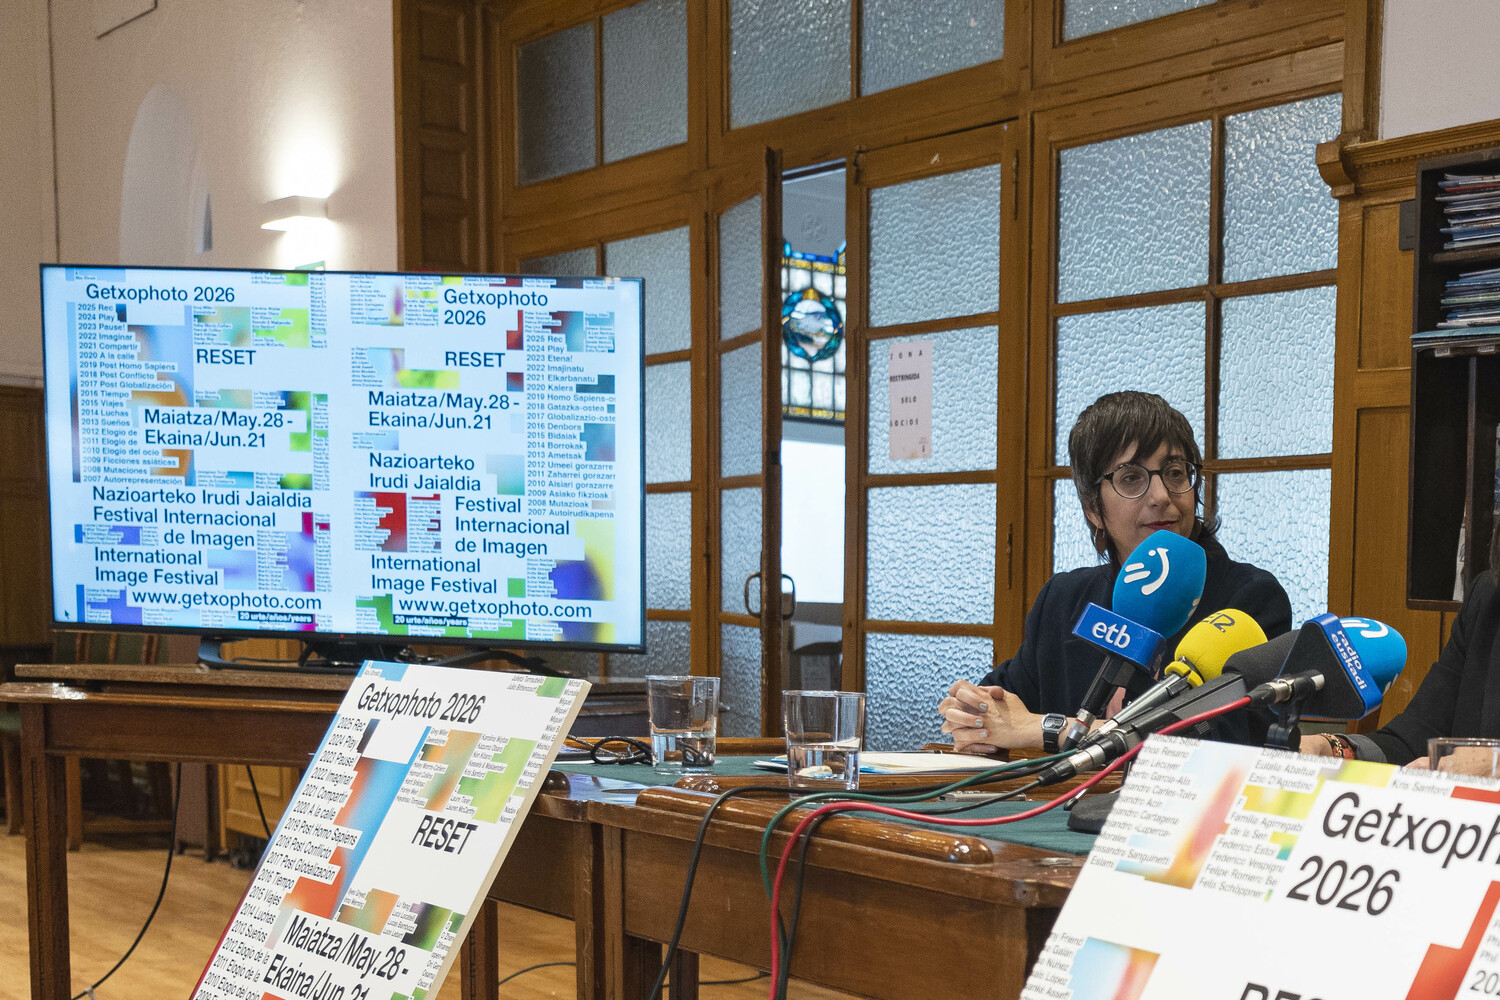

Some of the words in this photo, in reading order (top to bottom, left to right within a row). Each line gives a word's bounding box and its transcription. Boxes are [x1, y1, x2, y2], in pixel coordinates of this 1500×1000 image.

[85, 283, 188, 304] Getxophoto
[193, 286, 235, 303] 2026
[443, 288, 548, 310] Getxophoto
[78, 322, 97, 331] 2023
[98, 322, 125, 331] Pause!
[444, 309, 486, 326] 2026
[196, 348, 257, 365] RESET
[445, 351, 506, 368] RESET
[526, 383, 546, 392] 2020
[547, 384, 574, 392] Kalera
[368, 390, 510, 415] Maiatza/May.28
[144, 408, 284, 431] Maiatza/May.28
[369, 411, 491, 430] Ekaina/Jun.21
[145, 429, 265, 448] Ekaina/Jun.21
[369, 452, 475, 471] Nazioarteko
[370, 472, 408, 489] Irudi
[413, 474, 481, 492] Jaialdia
[92, 485, 196, 510] Nazioarteko
[202, 489, 240, 506] Irudi
[245, 485, 312, 508] Jaialdia
[455, 495, 521, 513] Festival
[90, 505, 158, 528] Festival
[164, 508, 276, 528] Internacional
[455, 516, 570, 535] Internacional
[163, 528, 185, 545] de
[191, 529, 255, 551] Imagen
[454, 537, 477, 553] de
[483, 537, 548, 559] Imagen
[94, 546, 202, 565] International
[371, 554, 481, 573] International
[95, 565, 148, 587] Image
[154, 568, 218, 586] Festival
[371, 574, 425, 595] Image
[431, 576, 497, 594] Festival
[131, 591, 322, 611] www.getxophoto.com
[398, 599, 592, 619] www.getxophoto.com
[1092, 620, 1131, 649] etb
[1336, 630, 1362, 670] radio
[1331, 632, 1367, 690] euskadi
[357, 682, 442, 721] Getxophoto
[439, 692, 486, 725] 2026
[336, 716, 355, 730] 2025
[353, 718, 367, 732] Rec
[328, 733, 346, 747] 2024
[343, 735, 357, 752] Play
[319, 750, 337, 764] 2023
[335, 752, 358, 767] Pause!
[310, 766, 329, 781] 2022
[325, 770, 354, 787] Imaginar
[301, 783, 319, 797] 2021
[316, 786, 349, 804] Compartir
[411, 814, 479, 855] RESET
[1285, 855, 1401, 916] 2026
[282, 914, 406, 981] Maiatza/May.28
